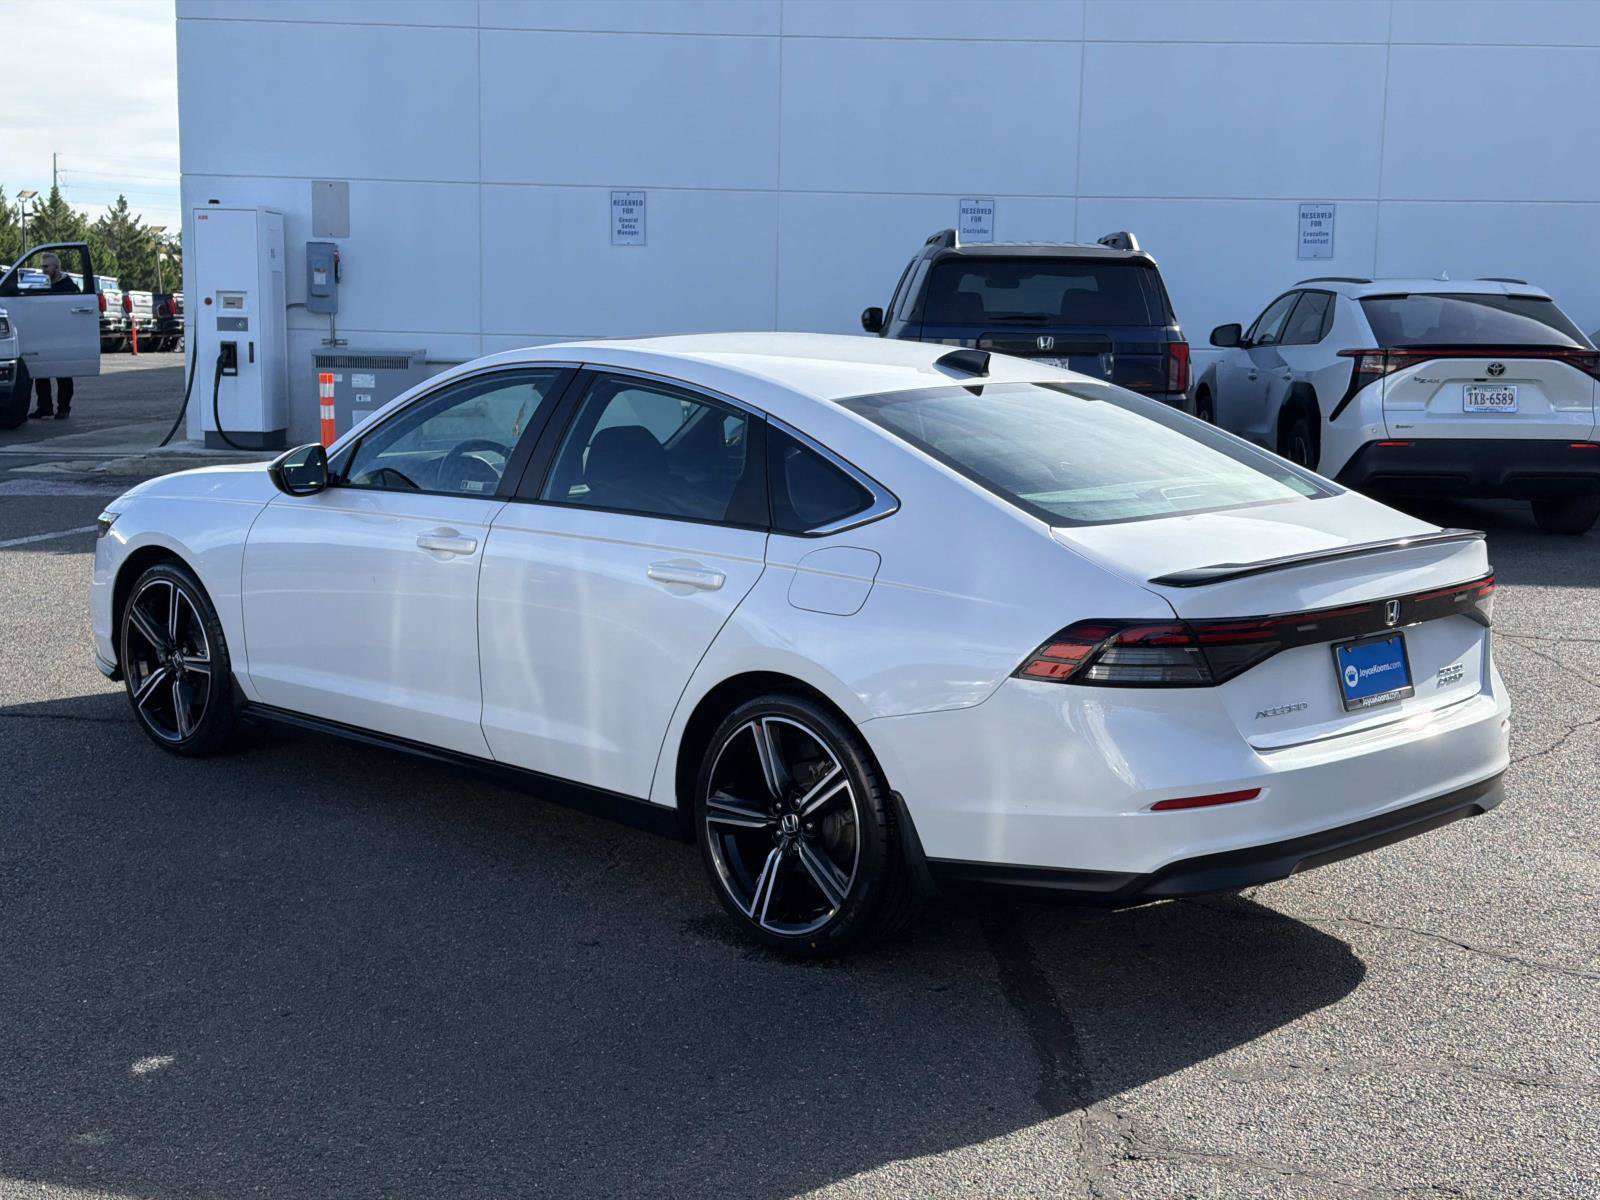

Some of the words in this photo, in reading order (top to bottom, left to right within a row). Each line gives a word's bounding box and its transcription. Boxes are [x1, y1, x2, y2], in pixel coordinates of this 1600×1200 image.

[961, 207, 992, 215] RESERVED
[1468, 392, 1514, 406] TKB-6589
[1359, 661, 1401, 678] JoyceKoons.com
[1361, 691, 1400, 706] JoyceKoons.com
[1255, 702, 1308, 719] ACCORD
